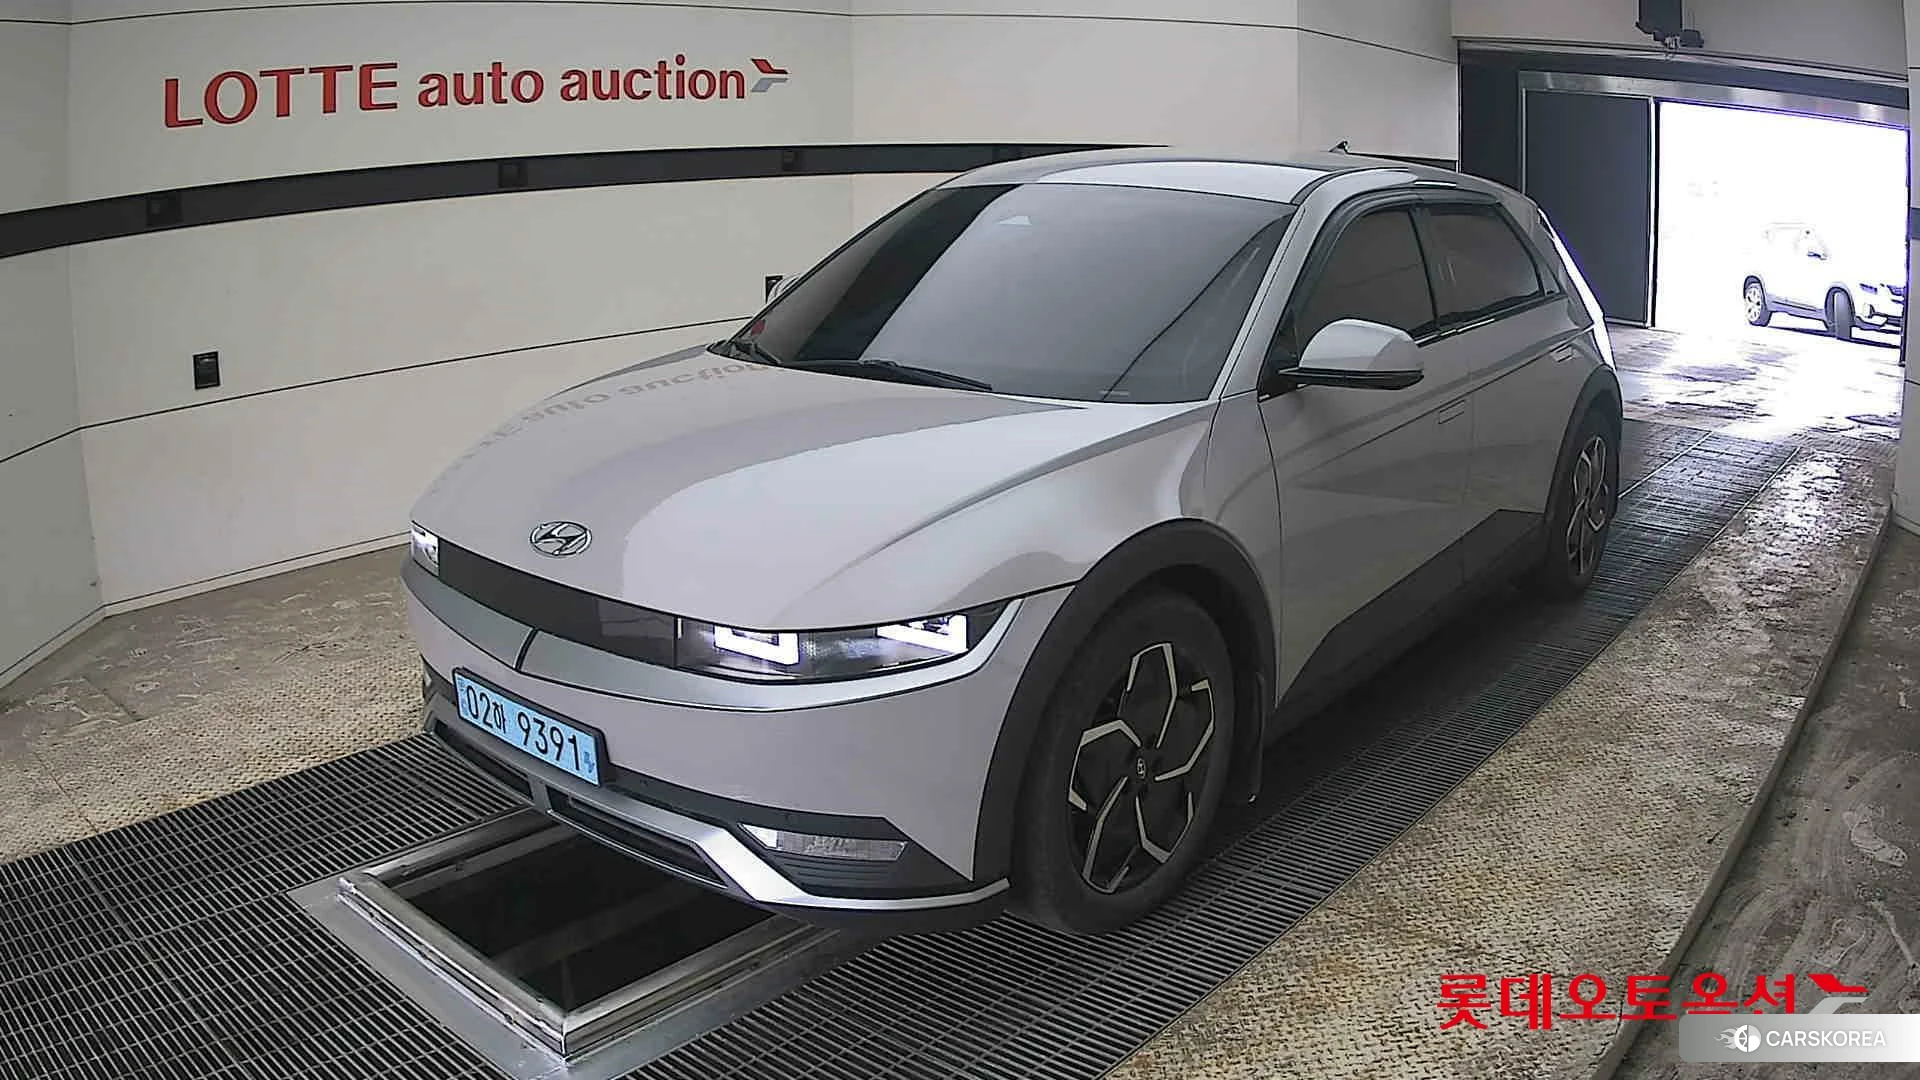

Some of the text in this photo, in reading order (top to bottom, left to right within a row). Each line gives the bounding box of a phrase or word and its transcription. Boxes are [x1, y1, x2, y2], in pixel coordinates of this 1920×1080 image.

[164, 54, 746, 128] LOTTE auto auction
[517, 711, 580, 771] 9391
